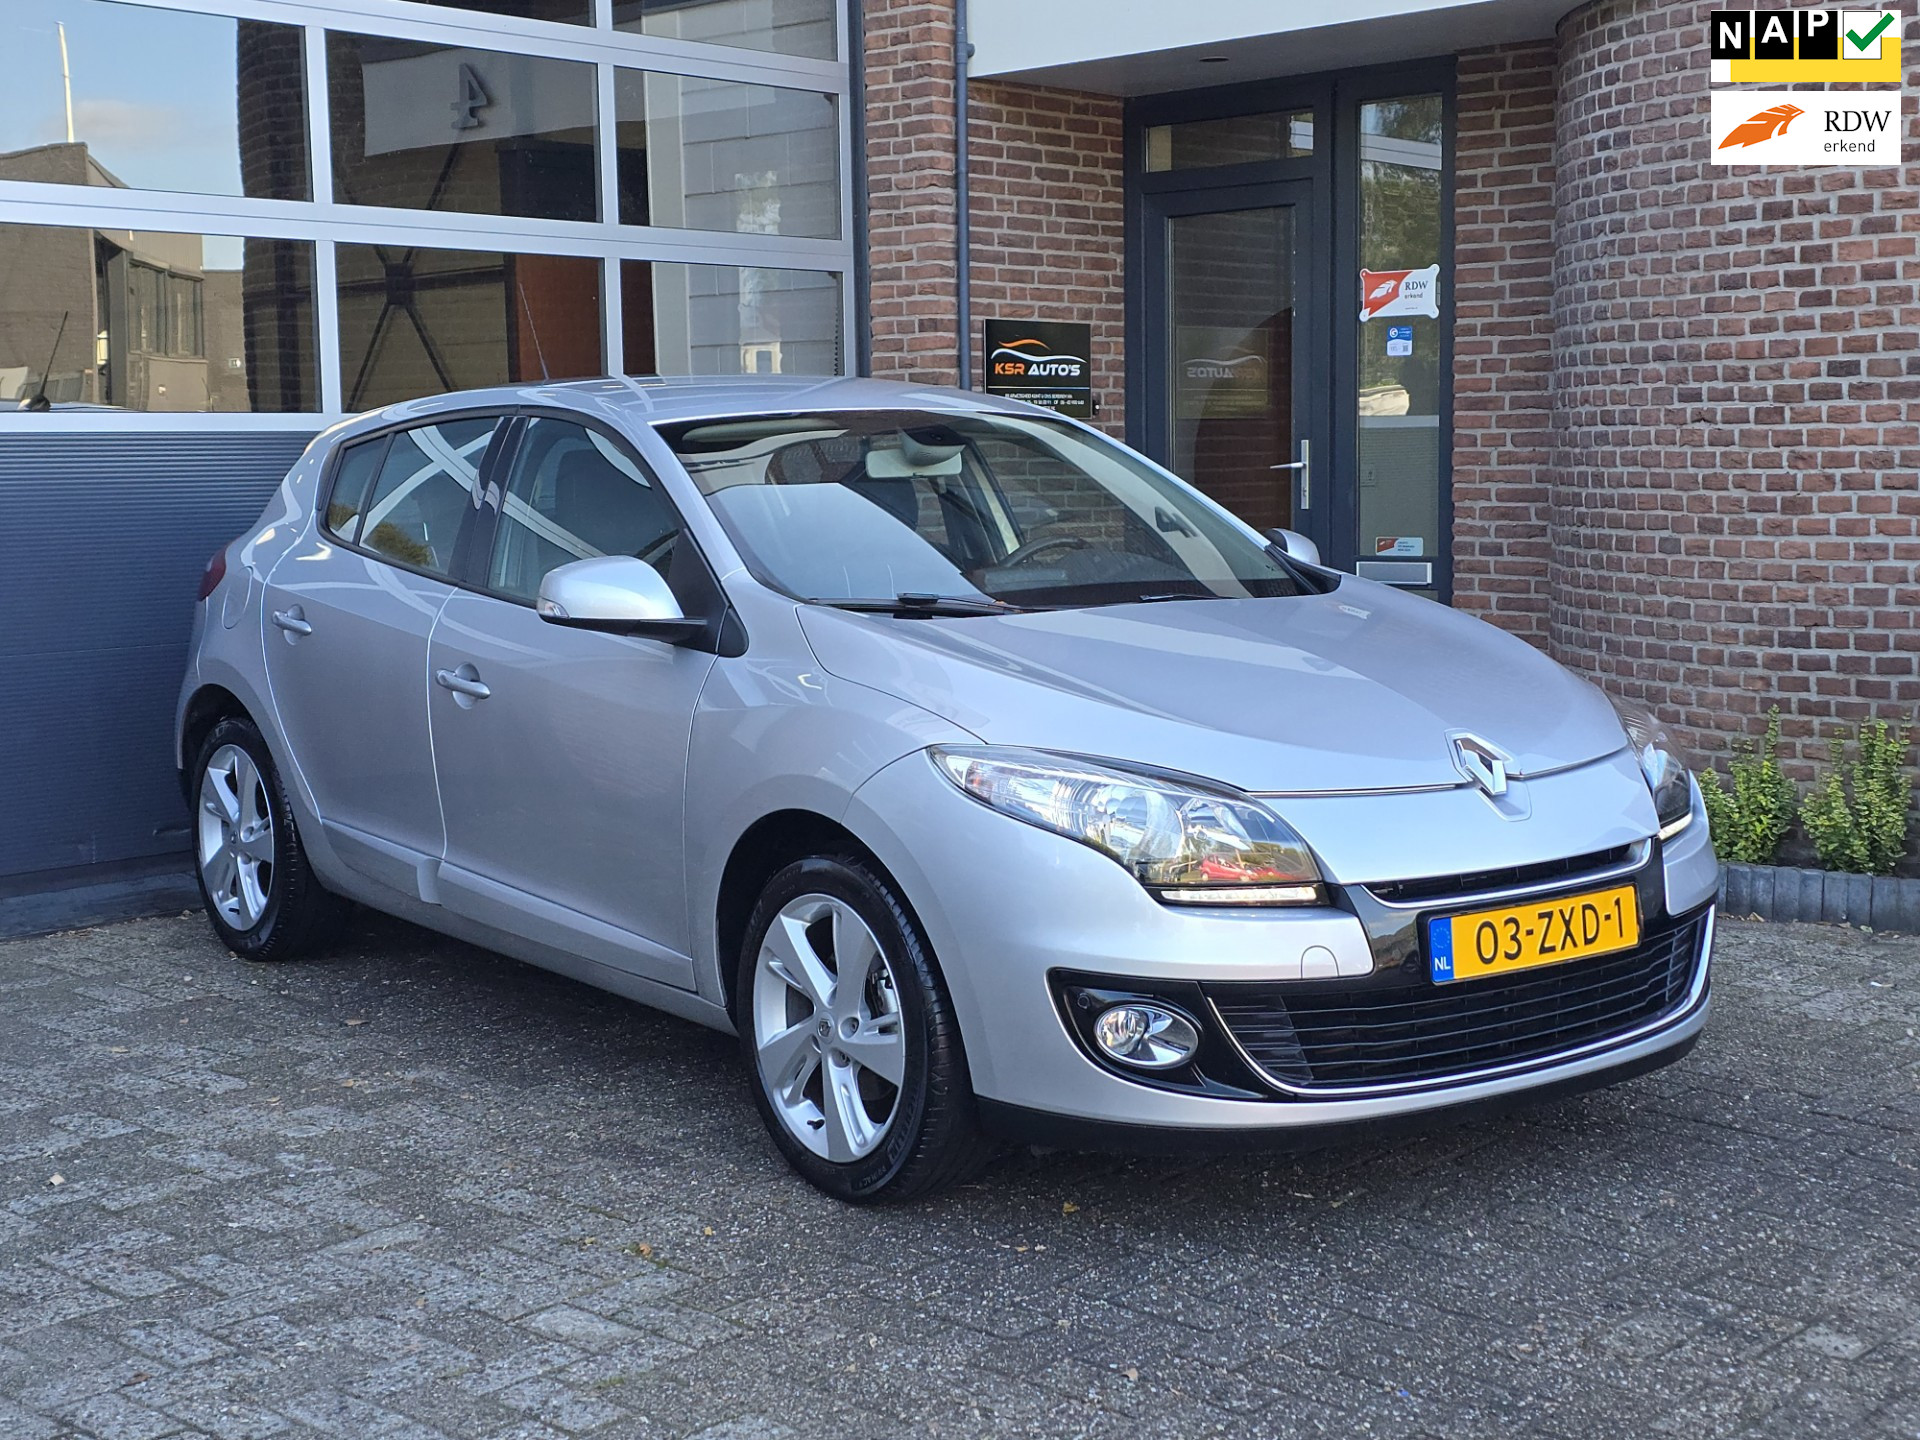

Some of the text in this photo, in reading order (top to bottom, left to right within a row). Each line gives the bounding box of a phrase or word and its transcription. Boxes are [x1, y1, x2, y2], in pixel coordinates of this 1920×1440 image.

[1405, 281, 1428, 291] RDW
[994, 363, 1081, 376] KSR AUTO'S
[1476, 897, 1624, 965] 03-ZXD-1
[1434, 956, 1451, 971] NL
